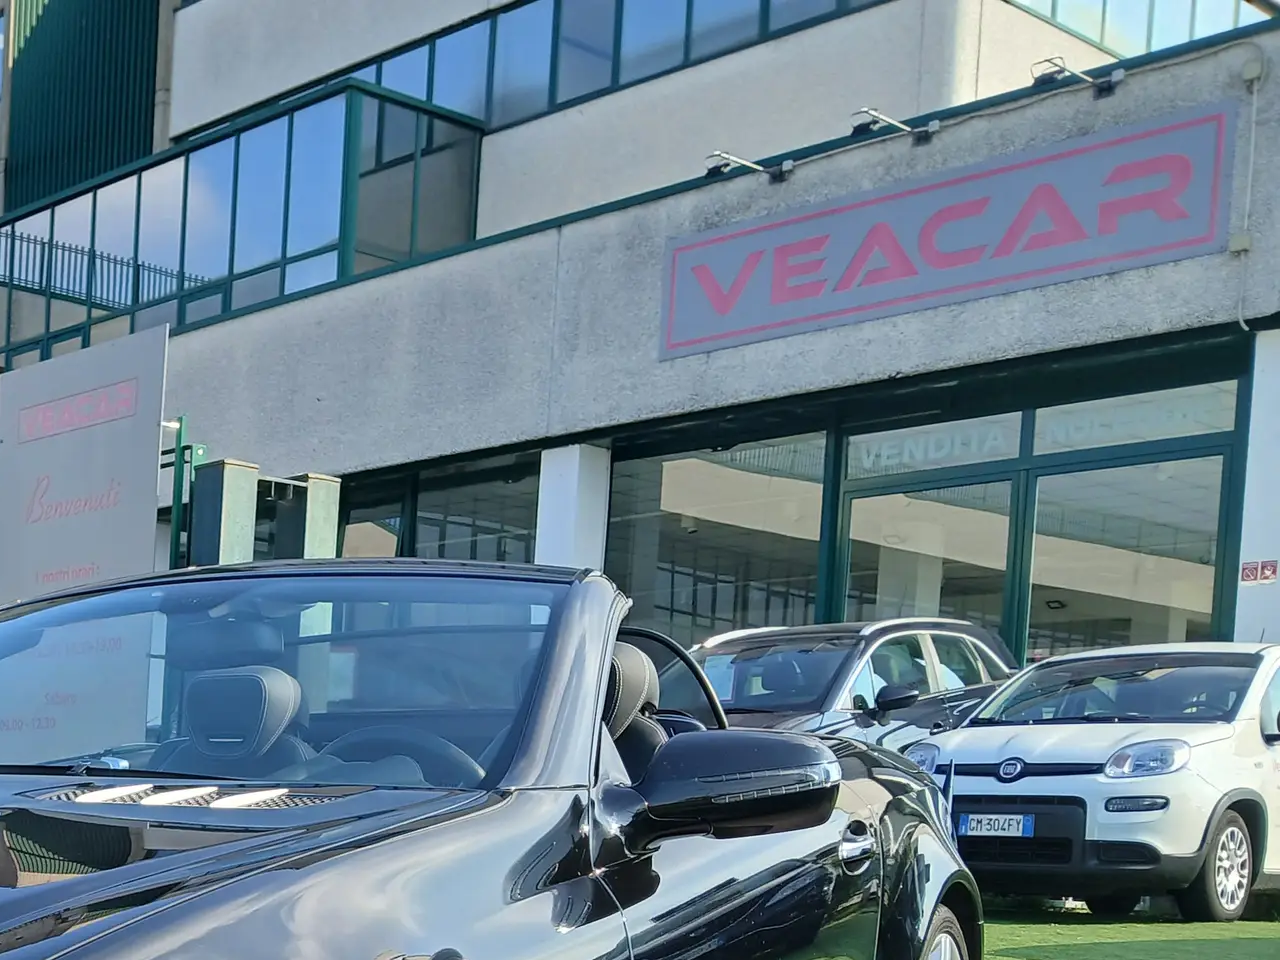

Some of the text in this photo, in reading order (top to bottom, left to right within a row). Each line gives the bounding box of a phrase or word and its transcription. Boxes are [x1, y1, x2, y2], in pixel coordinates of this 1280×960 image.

[690, 153, 1192, 317] VEACAR
[25, 381, 134, 440] VEACAR
[25, 474, 122, 525] Benvenuti
